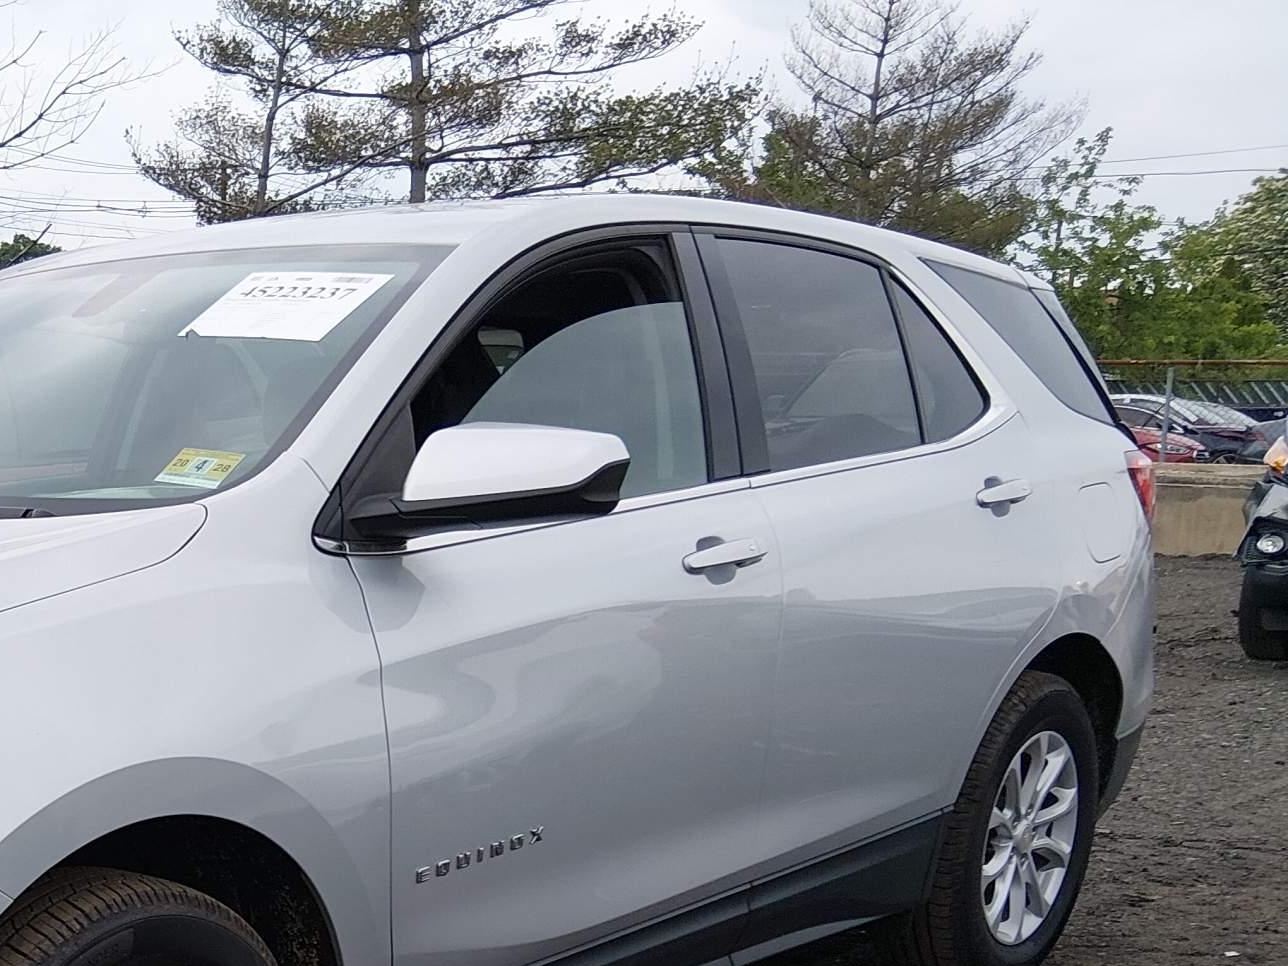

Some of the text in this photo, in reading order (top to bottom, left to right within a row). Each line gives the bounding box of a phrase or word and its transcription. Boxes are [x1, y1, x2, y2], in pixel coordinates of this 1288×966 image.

[240, 286, 358, 300] 45223237
[195, 459, 209, 473] 4
[414, 825, 545, 884] EQUINOX
